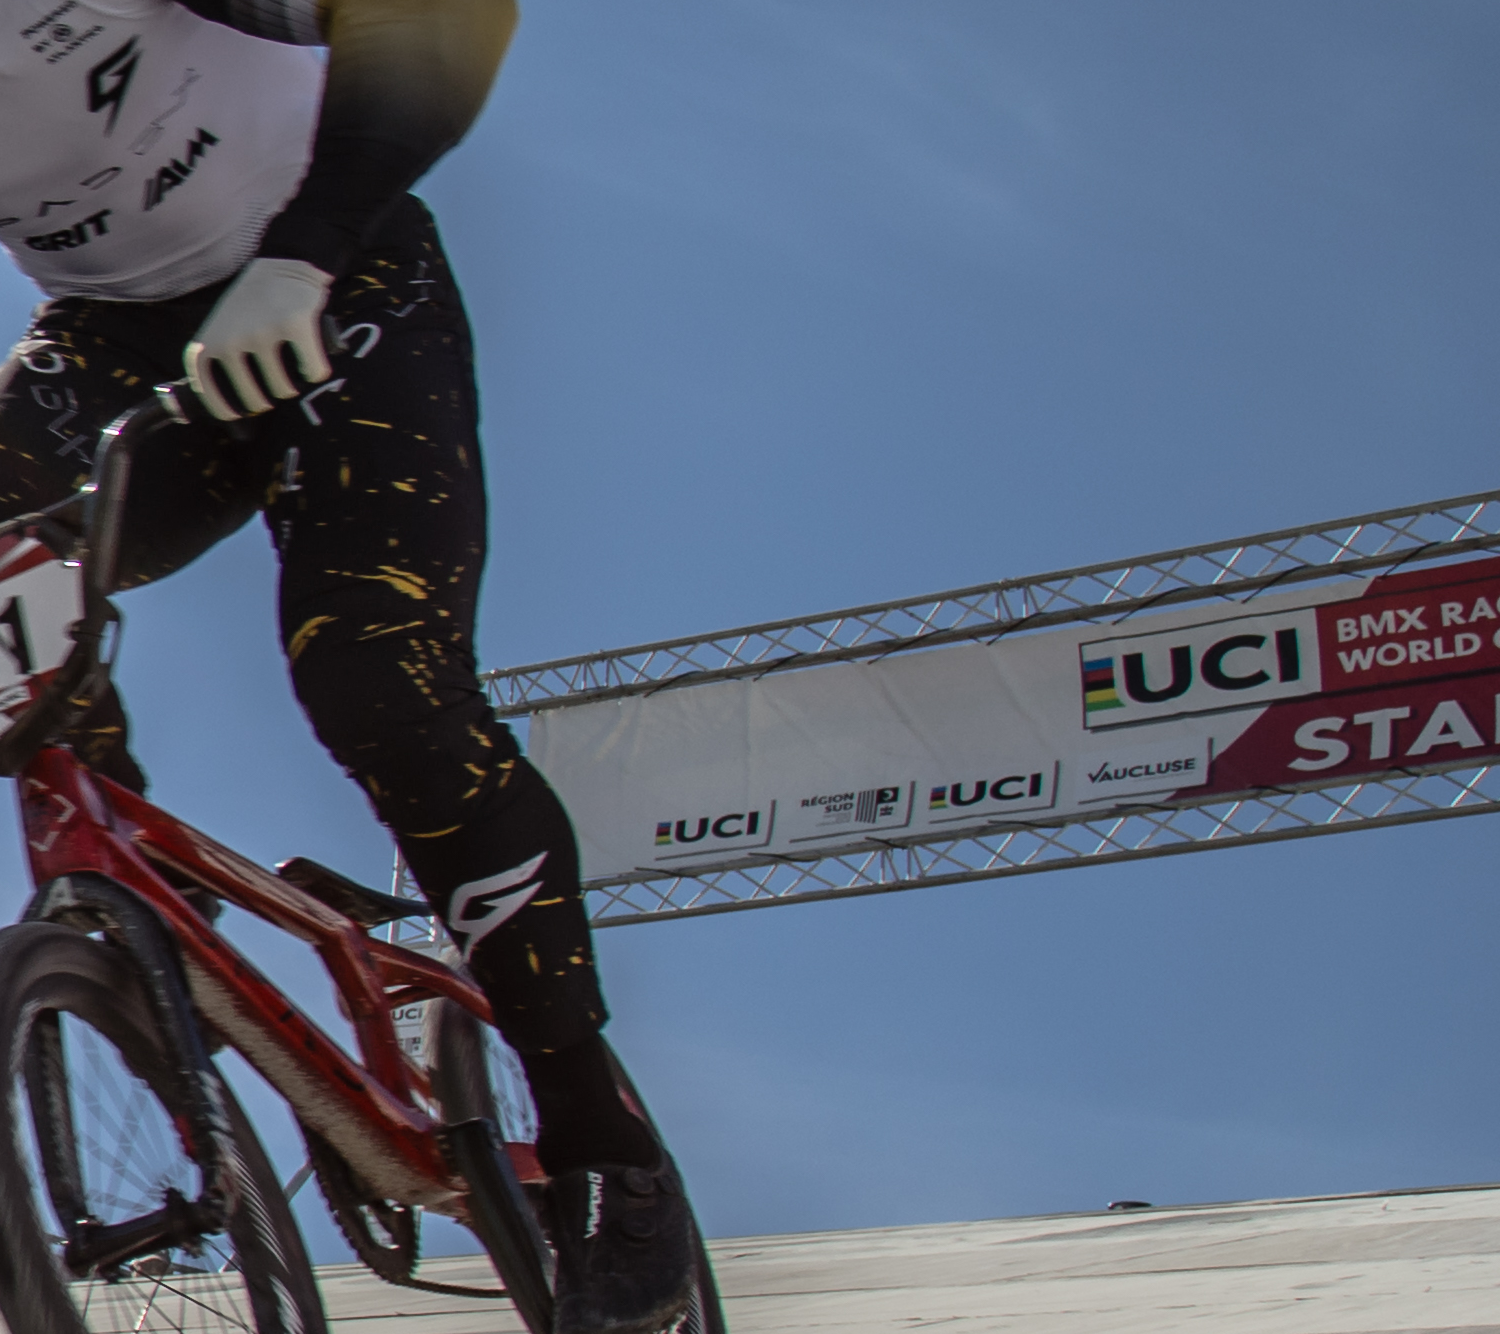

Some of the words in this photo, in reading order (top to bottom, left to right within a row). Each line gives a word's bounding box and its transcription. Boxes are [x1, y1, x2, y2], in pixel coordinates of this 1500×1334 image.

[23, 208, 112, 253] GRIT
[1335, 605, 1427, 644] BMX
[1122, 627, 1300, 704] UCI
[1336, 632, 1482, 674] WORLD
[1286, 692, 1500, 772] STA
[1088, 758, 1196, 784] VAUCLUSE
[800, 791, 855, 808] RÉGION
[950, 772, 1042, 806] UCI
[823, 802, 854, 814] SUD
[674, 810, 760, 844] UCI
[392, 1007, 423, 1022] UCI
